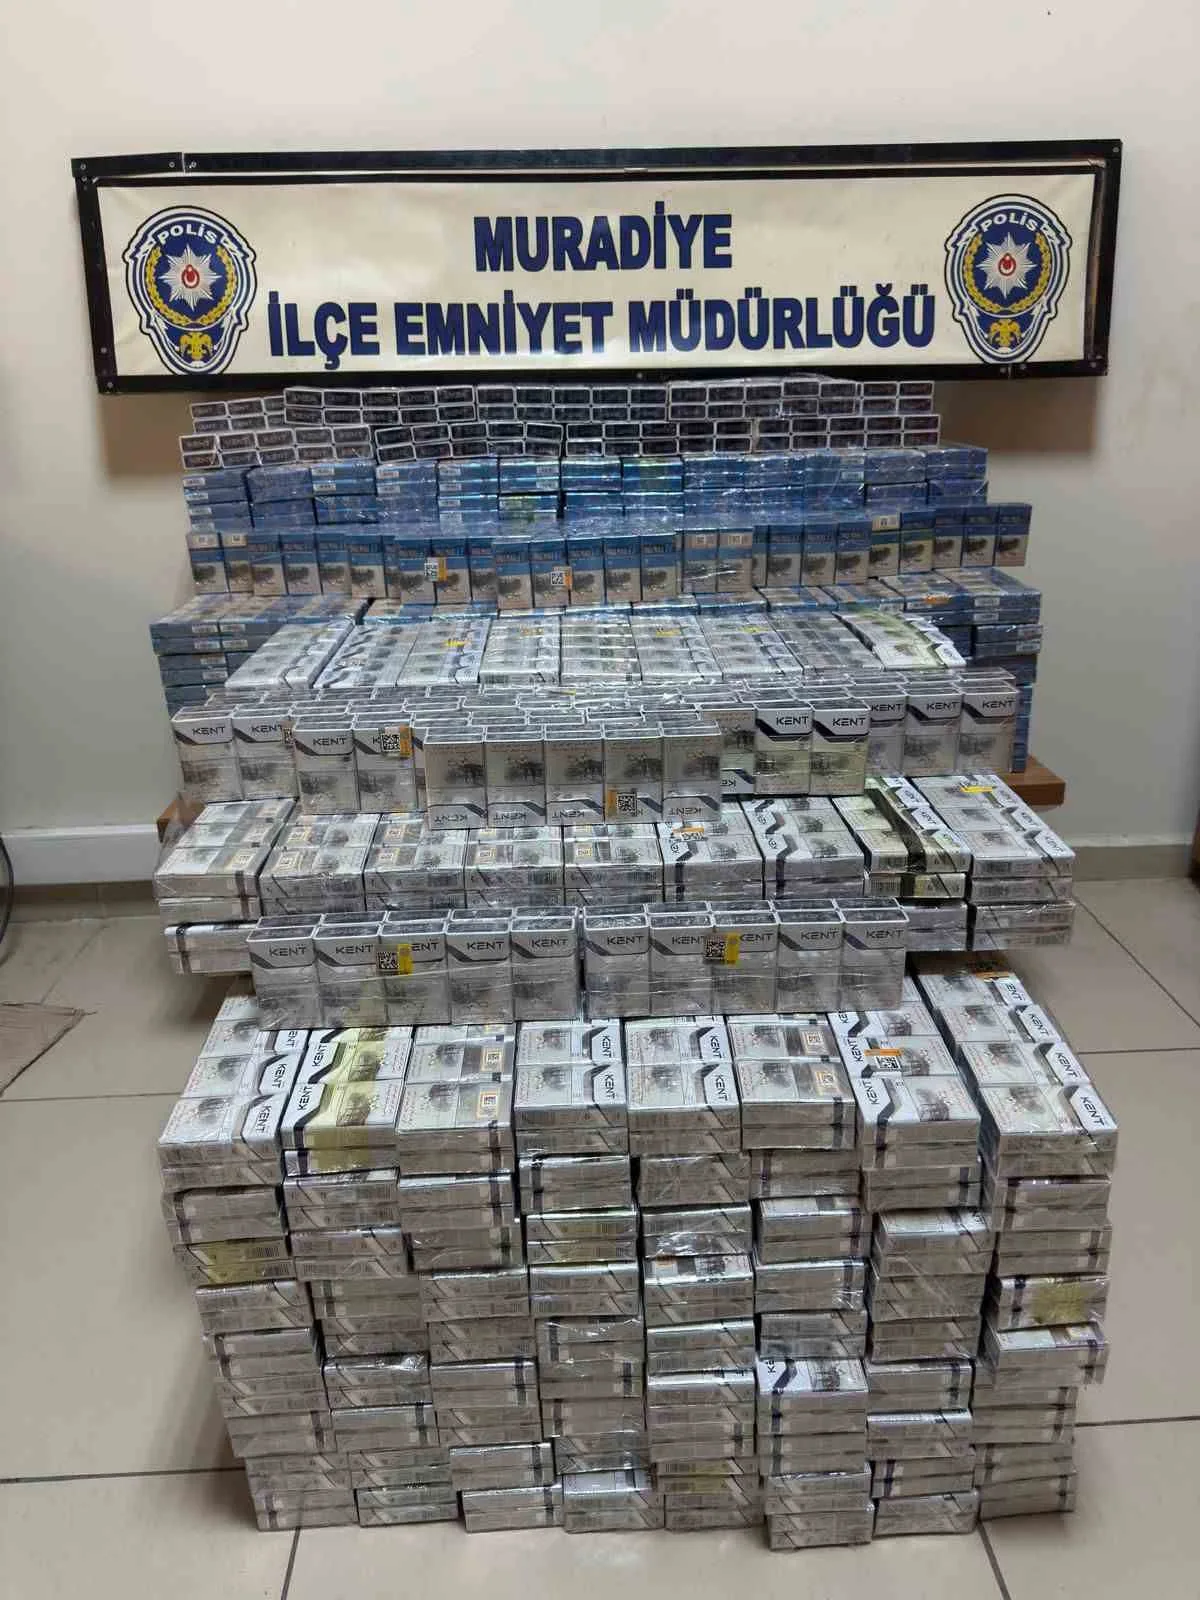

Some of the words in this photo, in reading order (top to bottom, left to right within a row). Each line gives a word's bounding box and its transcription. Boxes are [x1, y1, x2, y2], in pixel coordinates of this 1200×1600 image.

[980, 211, 1041, 233] POLİS
[158, 222, 219, 246] POLİS
[474, 201, 732, 272] MURADİYE
[267, 290, 380, 370] İLÇE
[394, 290, 611, 358] EMNİYET
[628, 283, 936, 353] MÜDÜRLÜĞÜ
[926, 701, 960, 711] KENT
[982, 700, 1016, 709] KENT
[192, 725, 227, 736] KENT
[776, 716, 810, 726] KENT
[832, 717, 866, 727] KENT
[313, 735, 347, 746] KENT
[531, 938, 568, 948] KENT
[607, 935, 644, 946] KENT
[800, 930, 840, 941] KENT
[866, 929, 904, 939] KENT
[269, 947, 307, 957] KENT
[335, 944, 373, 955] KENT
[411, 942, 439, 952] ENT
[467, 941, 504, 951] KENT
[1027, 1012, 1049, 1036] KENT
[312, 1044, 328, 1067] KENT
[602, 1034, 612, 1059] KENT
[711, 1034, 722, 1059] KENT
[849, 1038, 864, 1062] KENT
[271, 1063, 287, 1089] KENT
[1055, 1052, 1078, 1078] KENT
[297, 1084, 314, 1111] KENT
[604, 1073, 616, 1101] KENT
[716, 1073, 728, 1101] KENT
[864, 1080, 881, 1106] KENT
[256, 1105, 273, 1134] KENT
[1081, 1096, 1105, 1125] KENT
